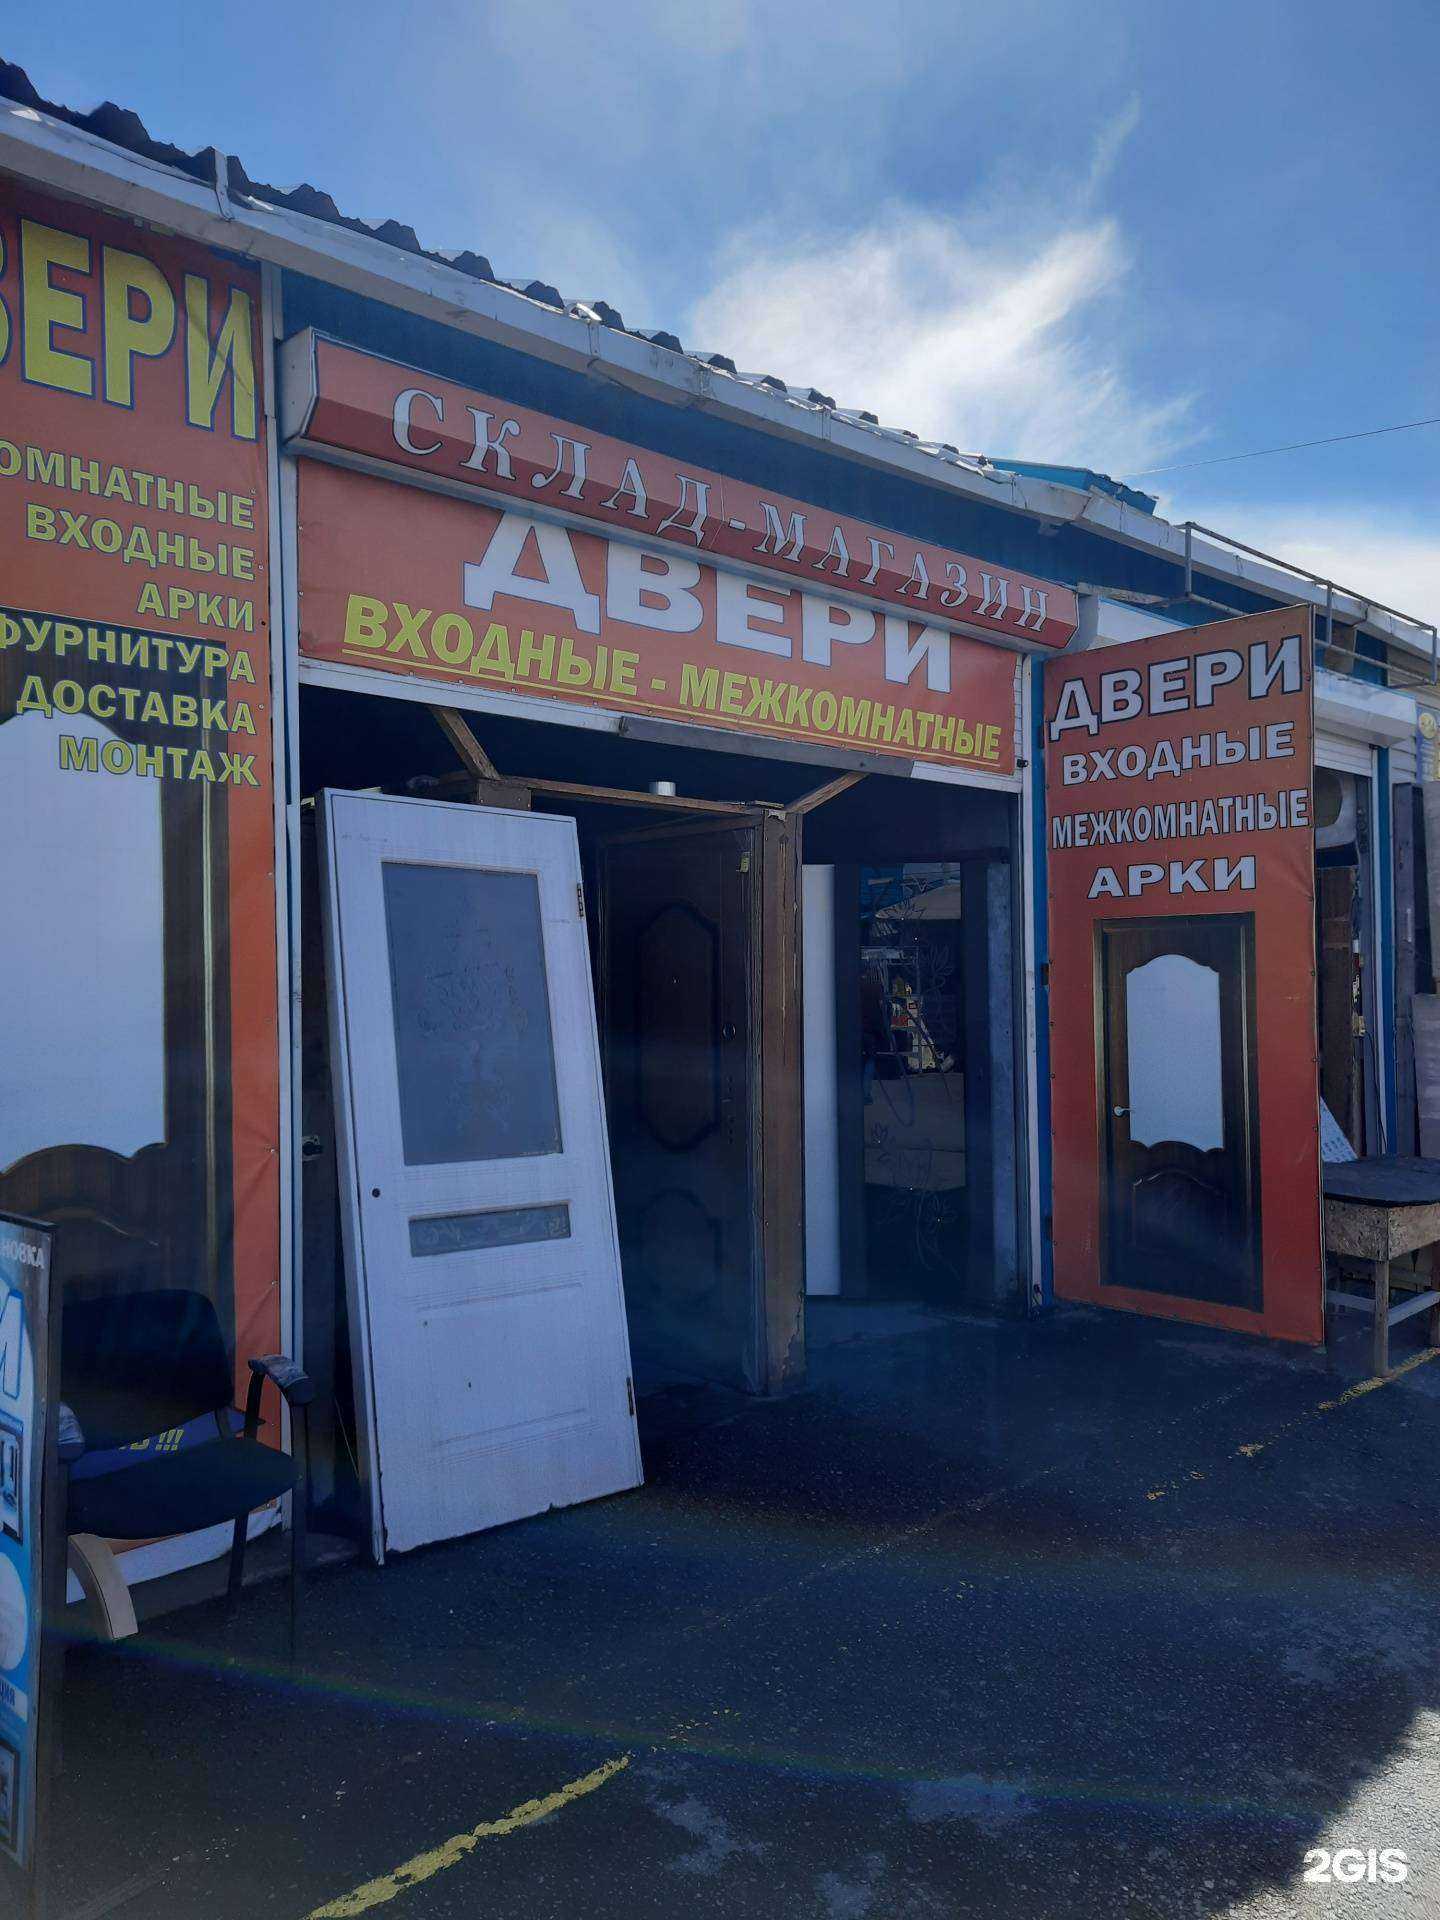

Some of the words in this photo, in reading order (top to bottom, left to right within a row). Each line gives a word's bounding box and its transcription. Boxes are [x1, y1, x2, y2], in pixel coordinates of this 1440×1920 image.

[0, 216, 258, 441] ЕРИ
[25, 502, 256, 581] ВХОДНЫЕ
[392, 387, 1051, 634] СКЛАД-МАГАЗИН
[136, 581, 256, 632] АРКИ
[462, 511, 952, 693] ДВЕРИ
[0, 612, 256, 684] ФУРНИТУРА
[343, 594, 640, 696] ВХОДНЫЕ
[679, 662, 1002, 760] МЕЖКОМНАТНЫЕ
[16, 675, 257, 735] ДОСТАВКА
[1049, 634, 1303, 742] ДВЕРИ
[58, 734, 260, 786] МОНТАЖ
[1062, 721, 1295, 786] ВХОДНЫЕ
[1052, 789, 1309, 849] МЕЖКОМНАТНЫЕ
[1087, 855, 1257, 899] АРКИ
